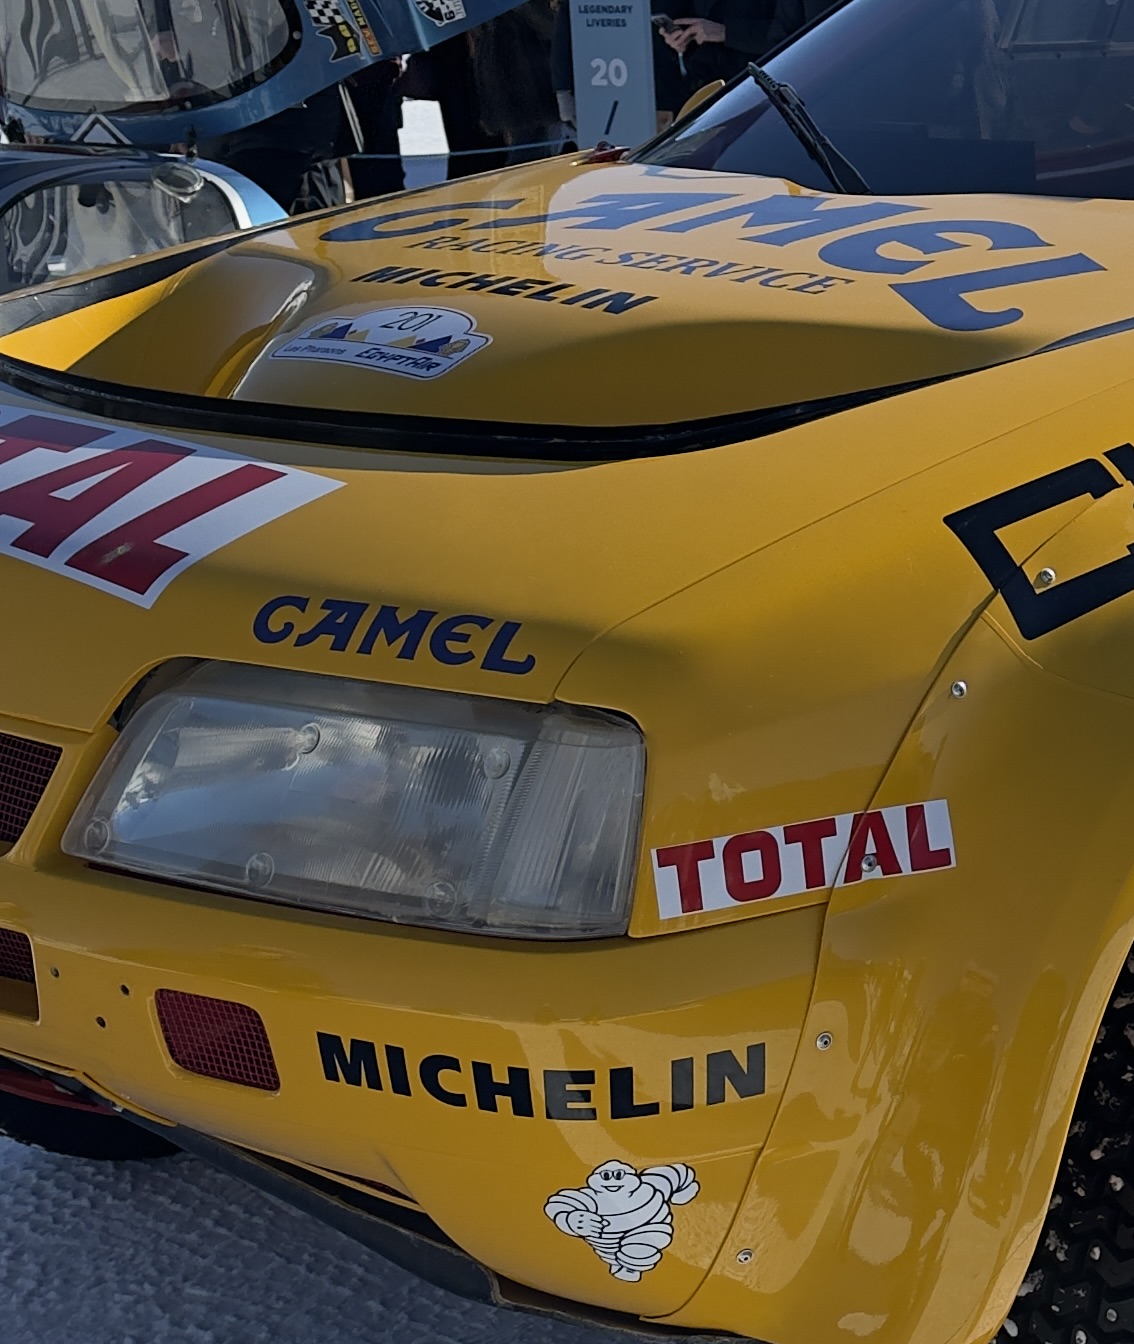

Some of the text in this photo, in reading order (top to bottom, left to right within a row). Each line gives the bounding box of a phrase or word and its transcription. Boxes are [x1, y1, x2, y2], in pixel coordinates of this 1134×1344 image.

[578, 4, 633, 15] LEGENDARY
[586, 17, 628, 28] LIVERIES
[590, 57, 629, 87] 20
[319, 192, 1108, 332] CAMEL
[405, 235, 855, 296] RACING SERVICE
[351, 265, 659, 315] MICHELIN
[379, 310, 444, 332] 201
[252, 595, 536, 675] CAMEL
[656, 803, 953, 914] TOTAL
[315, 1030, 767, 1121] MICHELIN
